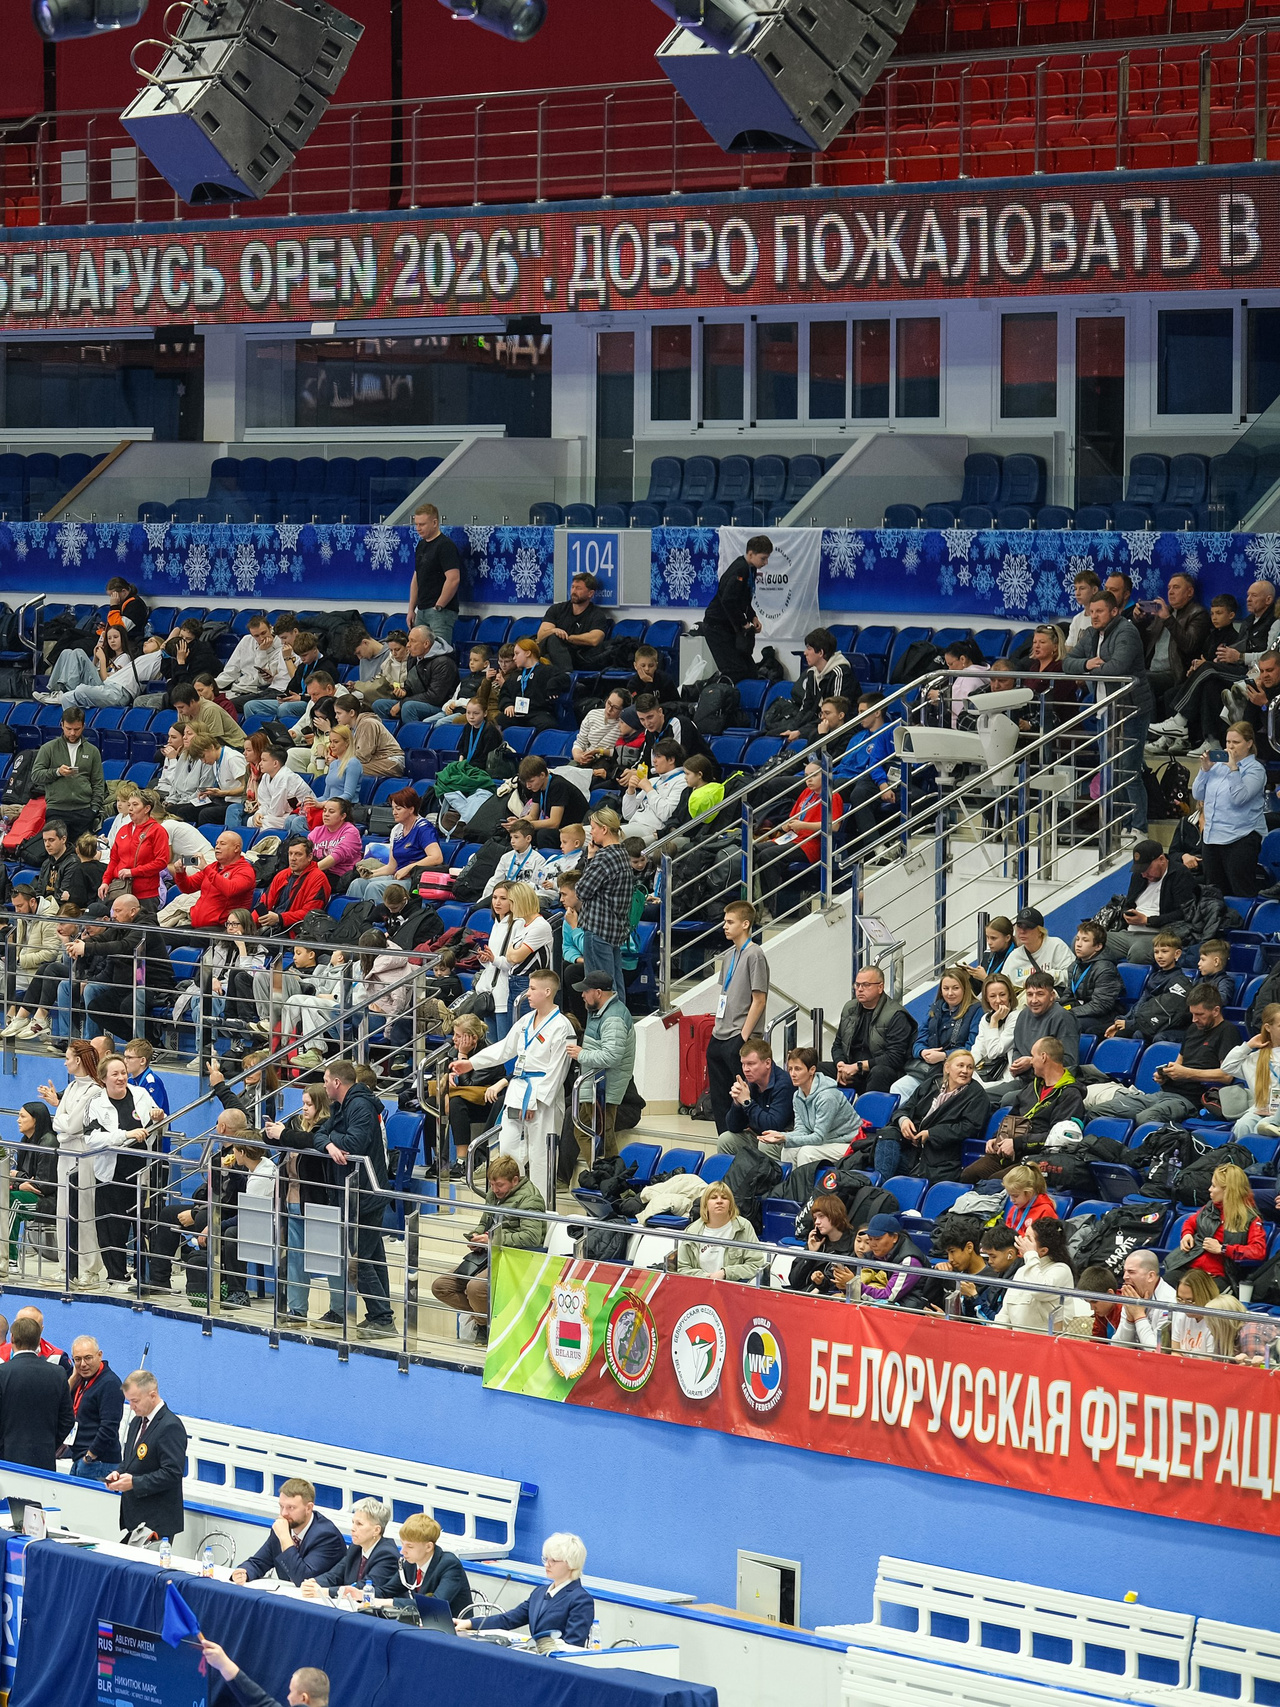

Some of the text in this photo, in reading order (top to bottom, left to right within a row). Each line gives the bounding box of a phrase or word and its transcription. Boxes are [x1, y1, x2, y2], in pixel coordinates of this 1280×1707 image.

[240, 234, 377, 304] OPEN
[567, 218, 758, 307] ДОБРО
[773, 197, 1201, 284] ПОЖАЛОВАТЬ
[1220, 193, 1261, 265] В
[572, 540, 614, 578] 104
[1105, 1236, 1137, 1268] KARATE
[752, 1317, 771, 1329] WORLD
[555, 1348, 582, 1360] BELARUS
[748, 1353, 773, 1375] WKF
[755, 1388, 783, 1412] FEDERATION
[808, 1337, 1280, 1500] БЕЛОРУССКАЯ ФЕДЕРАЦ
[98, 1637, 113, 1652] RUS
[115, 1634, 155, 1653] ABLEYEV ARTEM
[97, 1678, 113, 1693] BLR
[114, 1675, 141, 1691] НИКИТЮК
[141, 1682, 157, 1695] МАРК
